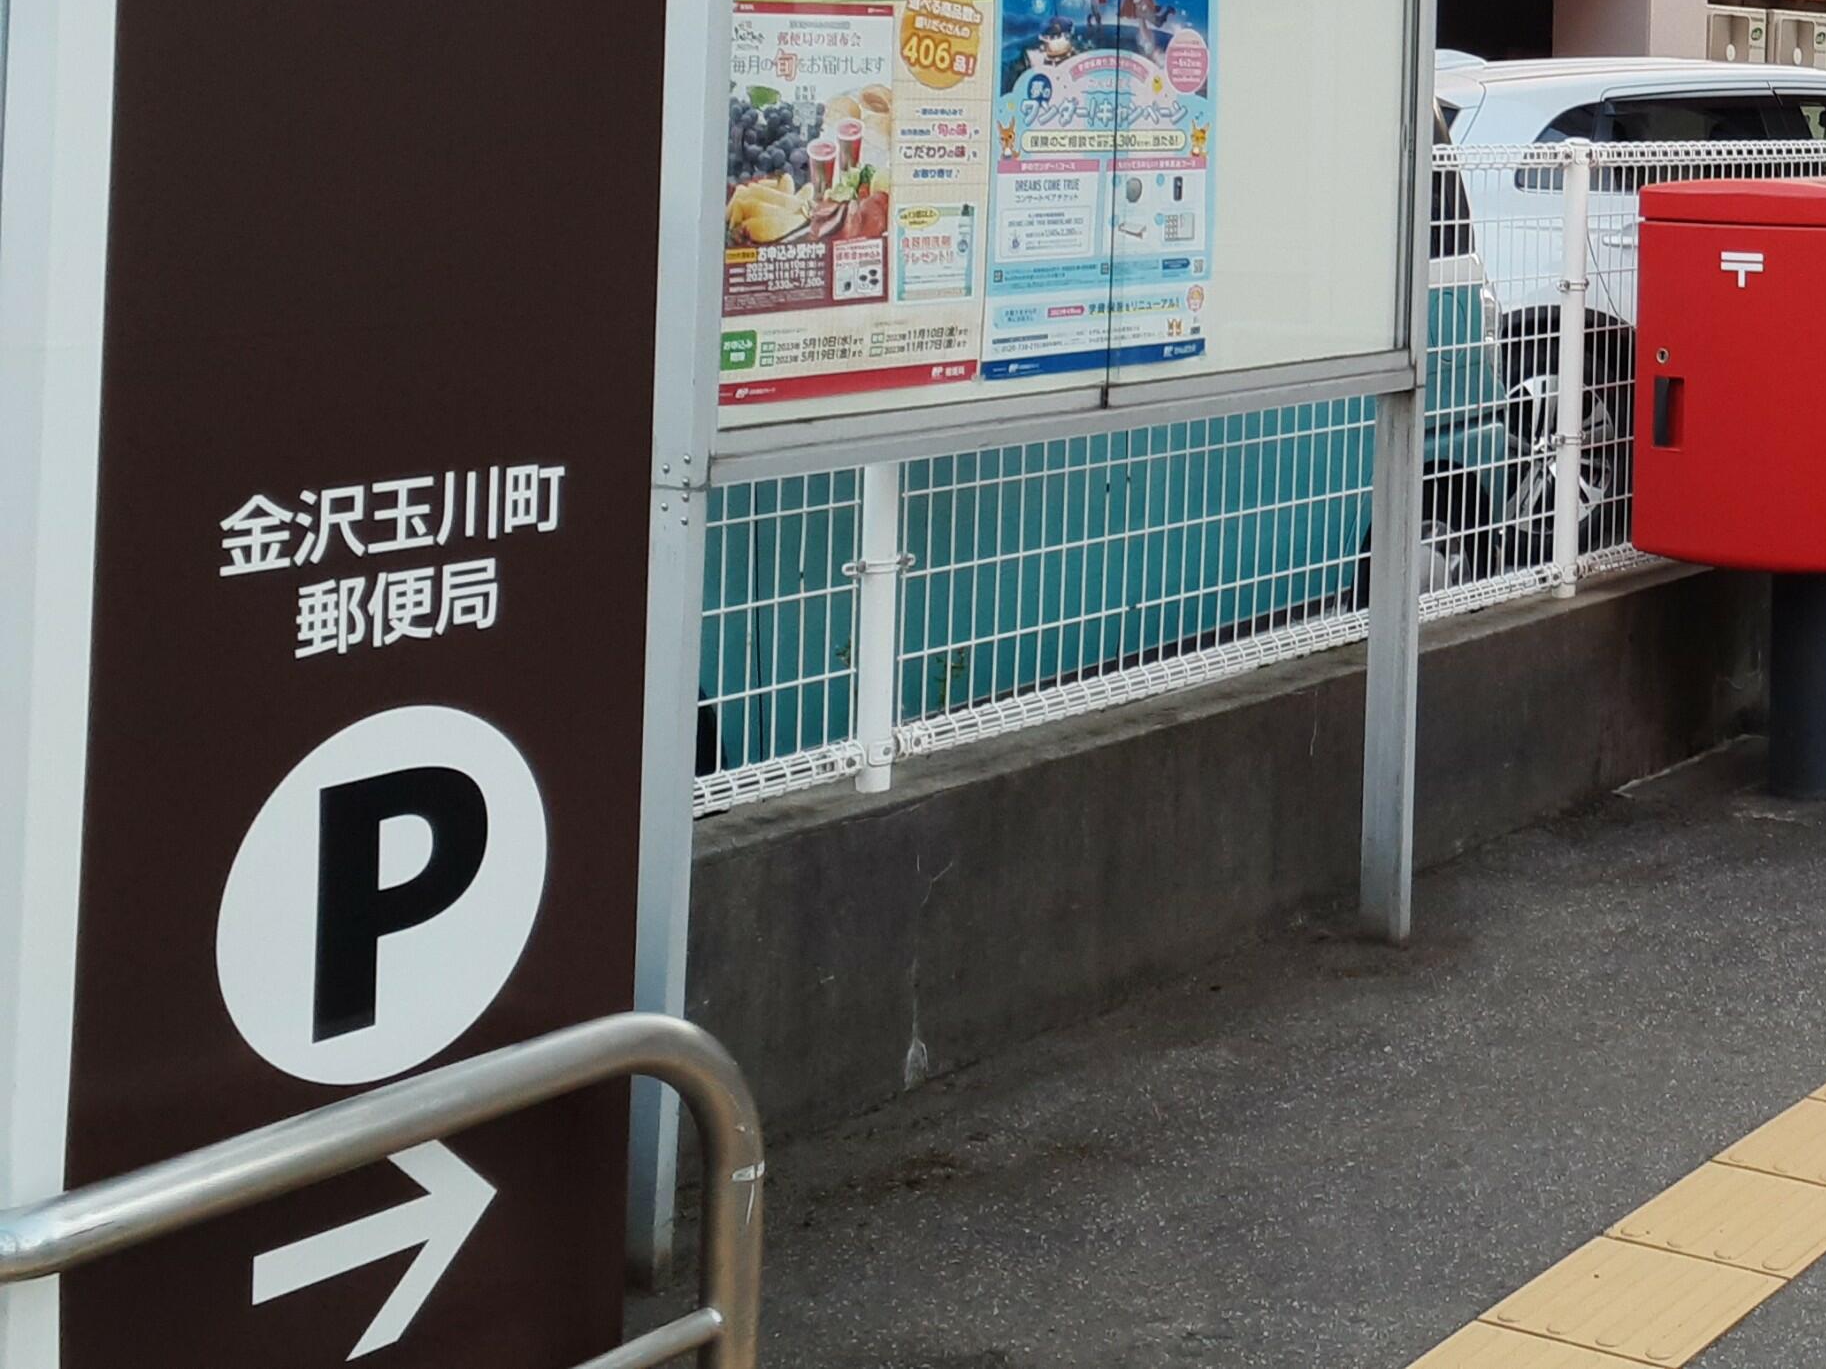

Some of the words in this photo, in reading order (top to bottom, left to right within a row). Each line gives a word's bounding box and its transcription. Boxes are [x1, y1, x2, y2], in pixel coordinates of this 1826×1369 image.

[732, 48, 885, 81] 毎月の旬をお届けします
[218, 464, 565, 577] 金沢玉川町
[294, 557, 498, 659] 郵便局
[311, 765, 489, 1044] P
